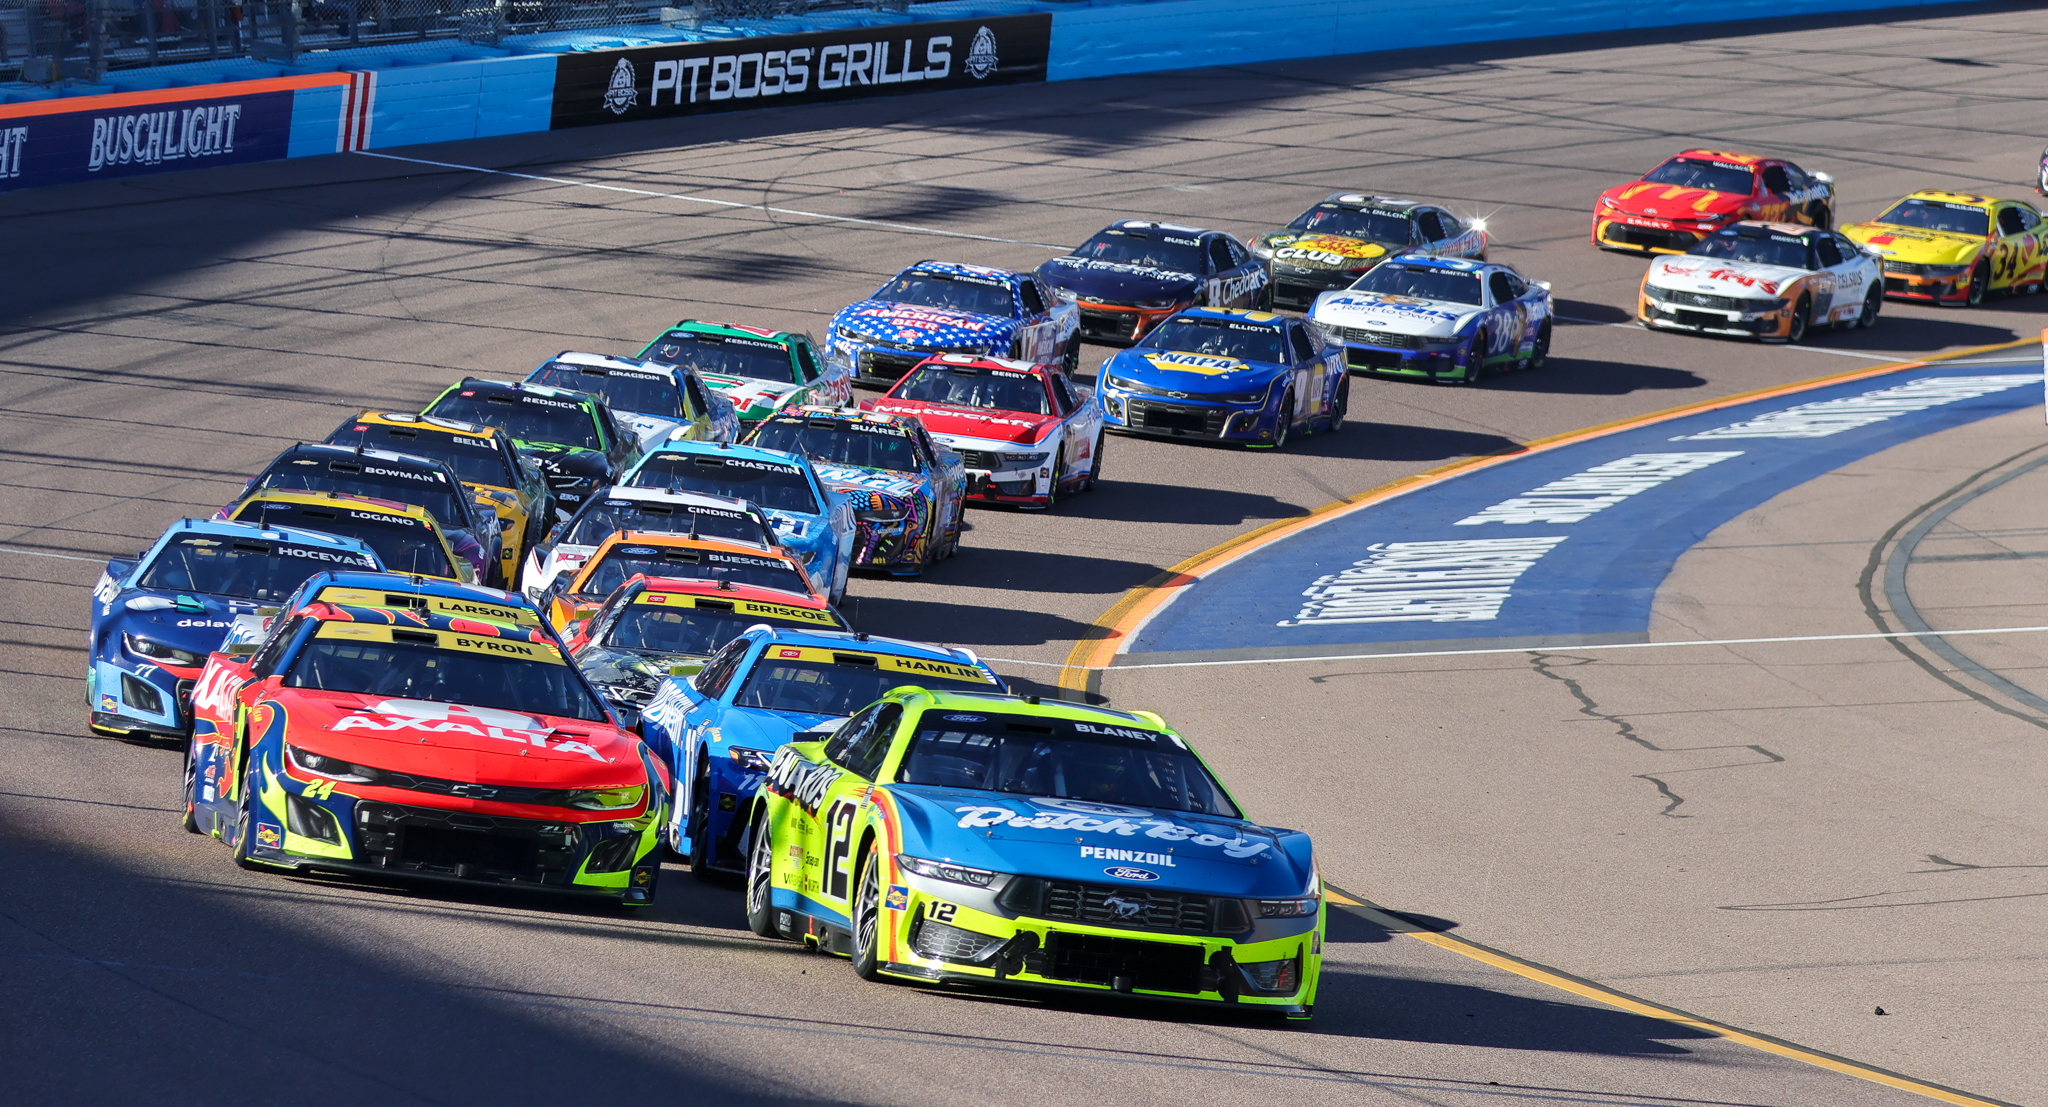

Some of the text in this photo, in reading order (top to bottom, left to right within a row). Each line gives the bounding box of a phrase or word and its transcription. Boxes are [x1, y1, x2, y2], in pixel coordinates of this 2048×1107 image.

[650, 35, 953, 107] PIT BOSS GRILLS
[1372, 209, 1407, 220] DILLON
[1164, 236, 1199, 247] BUSCH
[1276, 248, 1345, 266] CLUB
[954, 275, 998, 287] STENHOUSE
[858, 308, 986, 332] AMERICAN
[891, 317, 940, 332] BEER
[1229, 323, 1272, 333] ELLIOTT
[724, 337, 783, 351] KESELOWSKI
[1160, 353, 1232, 370] NAPA
[608, 370, 660, 381] GRAGSON
[991, 370, 1027, 380] BERRY
[522, 396, 577, 410] REDDICK
[874, 405, 1035, 430] Motorcraft
[850, 422, 906, 437] SUÁREZ
[453, 436, 489, 449] BELL
[365, 466, 434, 483] BOWMAN
[725, 459, 801, 476] CHASTAIN
[350, 510, 415, 526] LOGANO
[687, 506, 743, 520] CINDRIC
[278, 547, 370, 567] HOCEVAR
[708, 553, 792, 571] BUESCHER
[438, 602, 518, 619] LARSON
[745, 602, 827, 623] BRISCOE
[456, 638, 533, 656] BYRON
[133, 663, 159, 678] 77
[895, 659, 980, 679] HAMLIN
[330, 715, 608, 763] AXALTA
[1074, 723, 1158, 742] BLANEY
[301, 779, 338, 800] 24
[955, 806, 1145, 836] Dutch
[1140, 818, 1270, 859] Boy
[821, 799, 857, 904] 12
[1080, 845, 1177, 868] PENNZOIL
[928, 901, 958, 922] 12
